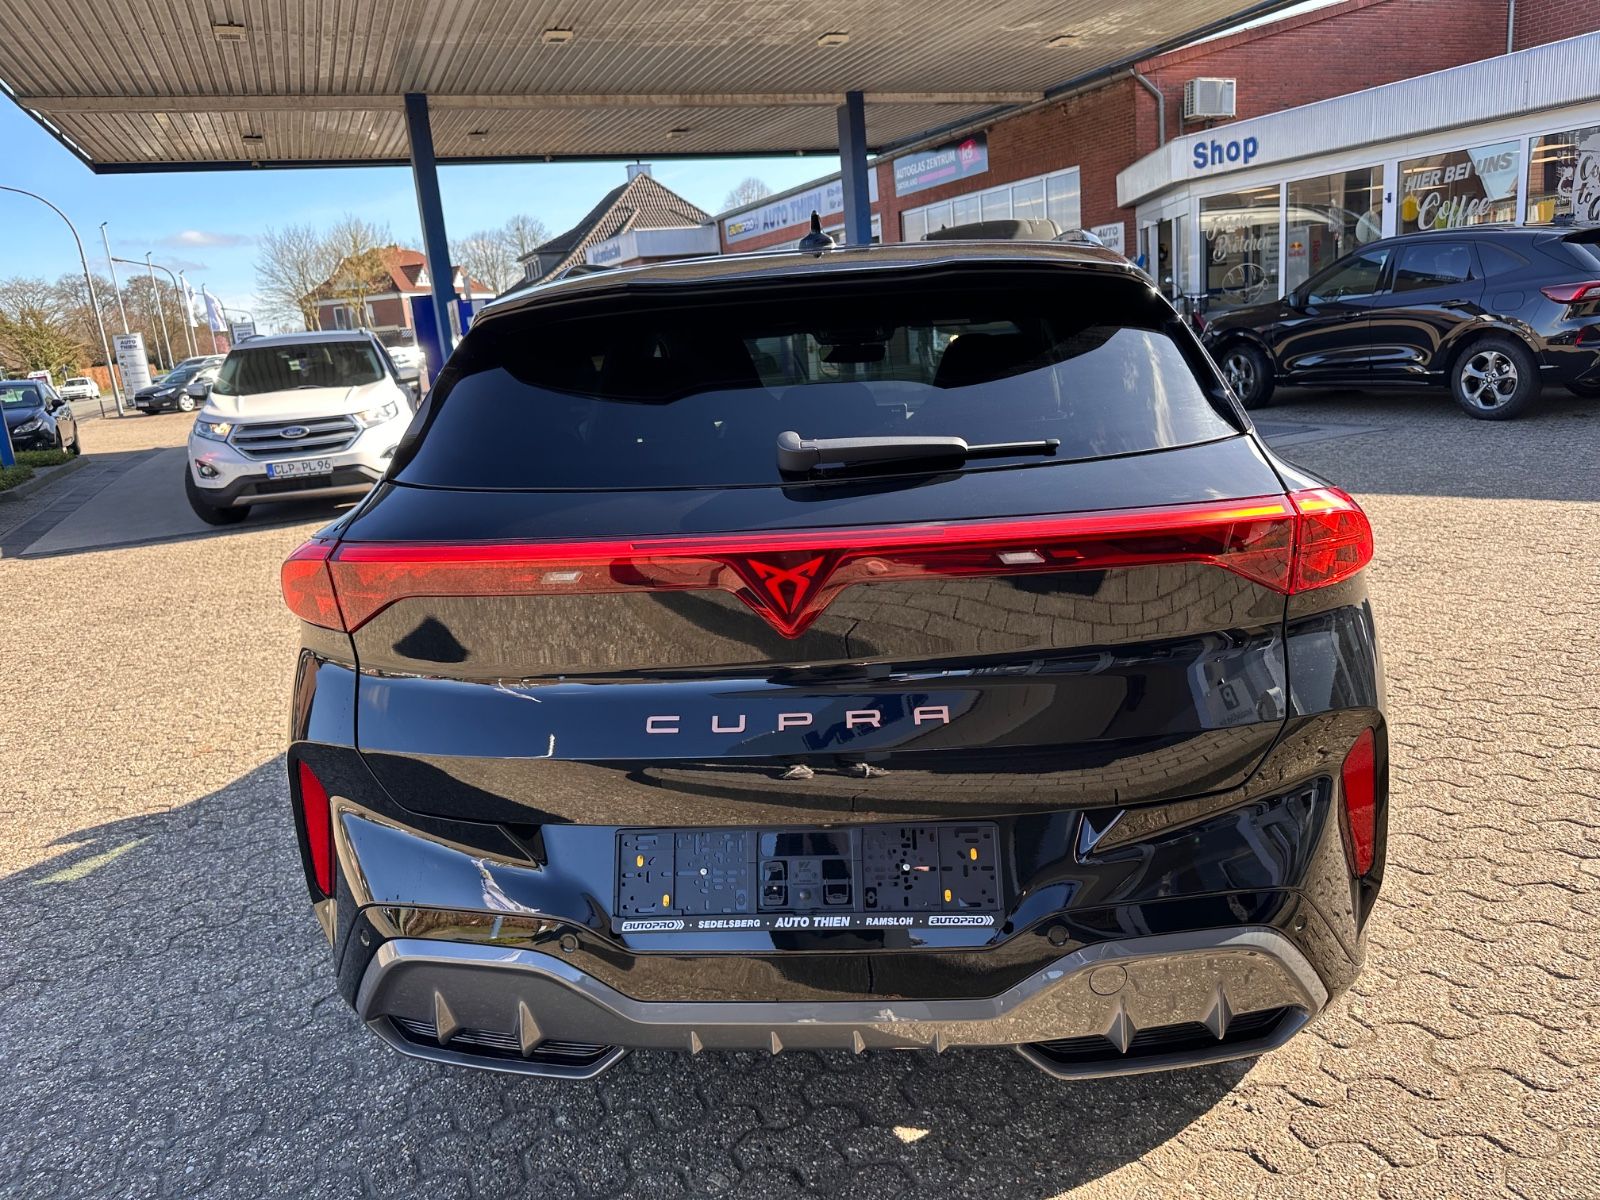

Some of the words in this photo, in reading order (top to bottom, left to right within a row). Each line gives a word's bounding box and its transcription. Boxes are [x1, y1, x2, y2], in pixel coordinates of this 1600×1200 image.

[926, 150, 956, 170] ZENTRUM
[1193, 136, 1258, 169] Shop
[1405, 170, 1442, 193] HIER
[1444, 162, 1472, 184] BEI
[1476, 152, 1513, 175] UNS
[1575, 182, 1593, 205] to
[763, 206, 788, 230] AUTO
[790, 193, 822, 222] THIEN
[1416, 191, 1491, 230] Coffee
[1098, 226, 1118, 238] AUTO
[274, 463, 295, 475] CLP
[302, 462, 316, 472] PL
[317, 459, 331, 469] 96
[645, 705, 950, 734] CUPRA
[698, 919, 761, 929] SEDELSBERG
[775, 916, 809, 928] AUTO
[813, 916, 851, 928] THIEN
[866, 917, 914, 926] RAMSLOH
